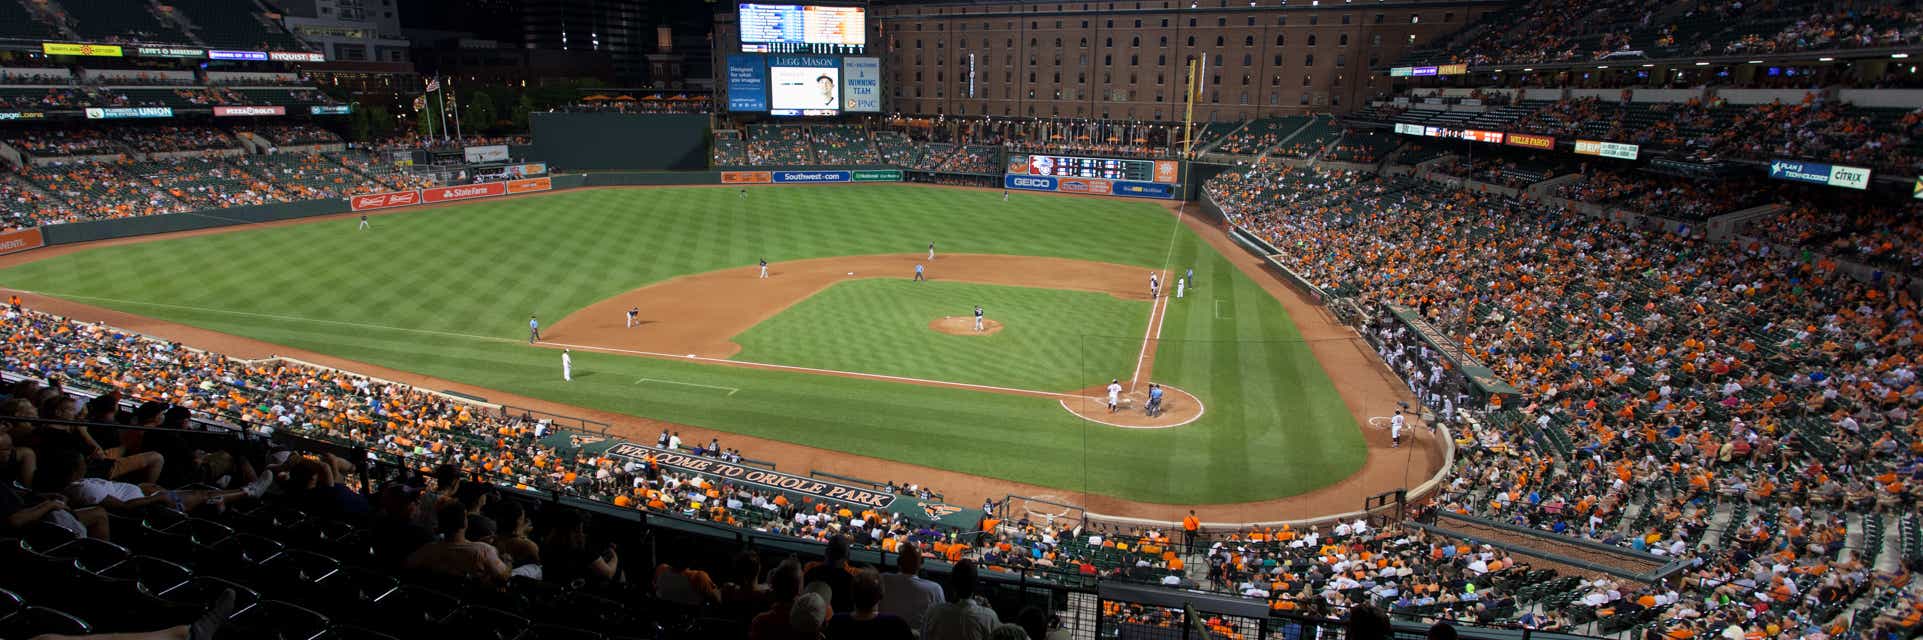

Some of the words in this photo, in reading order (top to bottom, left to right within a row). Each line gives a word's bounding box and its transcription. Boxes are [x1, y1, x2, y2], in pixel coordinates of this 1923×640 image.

[776, 57, 800, 66] LEGG
[801, 57, 833, 67] MASON
[848, 79, 876, 87] WINNING
[853, 87, 872, 95] TEAM
[857, 99, 876, 108] PNC
[139, 107, 172, 116] UNION
[1510, 135, 1530, 145] WELLS
[1781, 162, 1798, 171] PLAN
[1014, 177, 1050, 188] GEICO
[616, 444, 712, 471] WECOME
[713, 463, 744, 477] TO
[745, 470, 827, 494] ORIOLE
[826, 486, 889, 507] PARK
